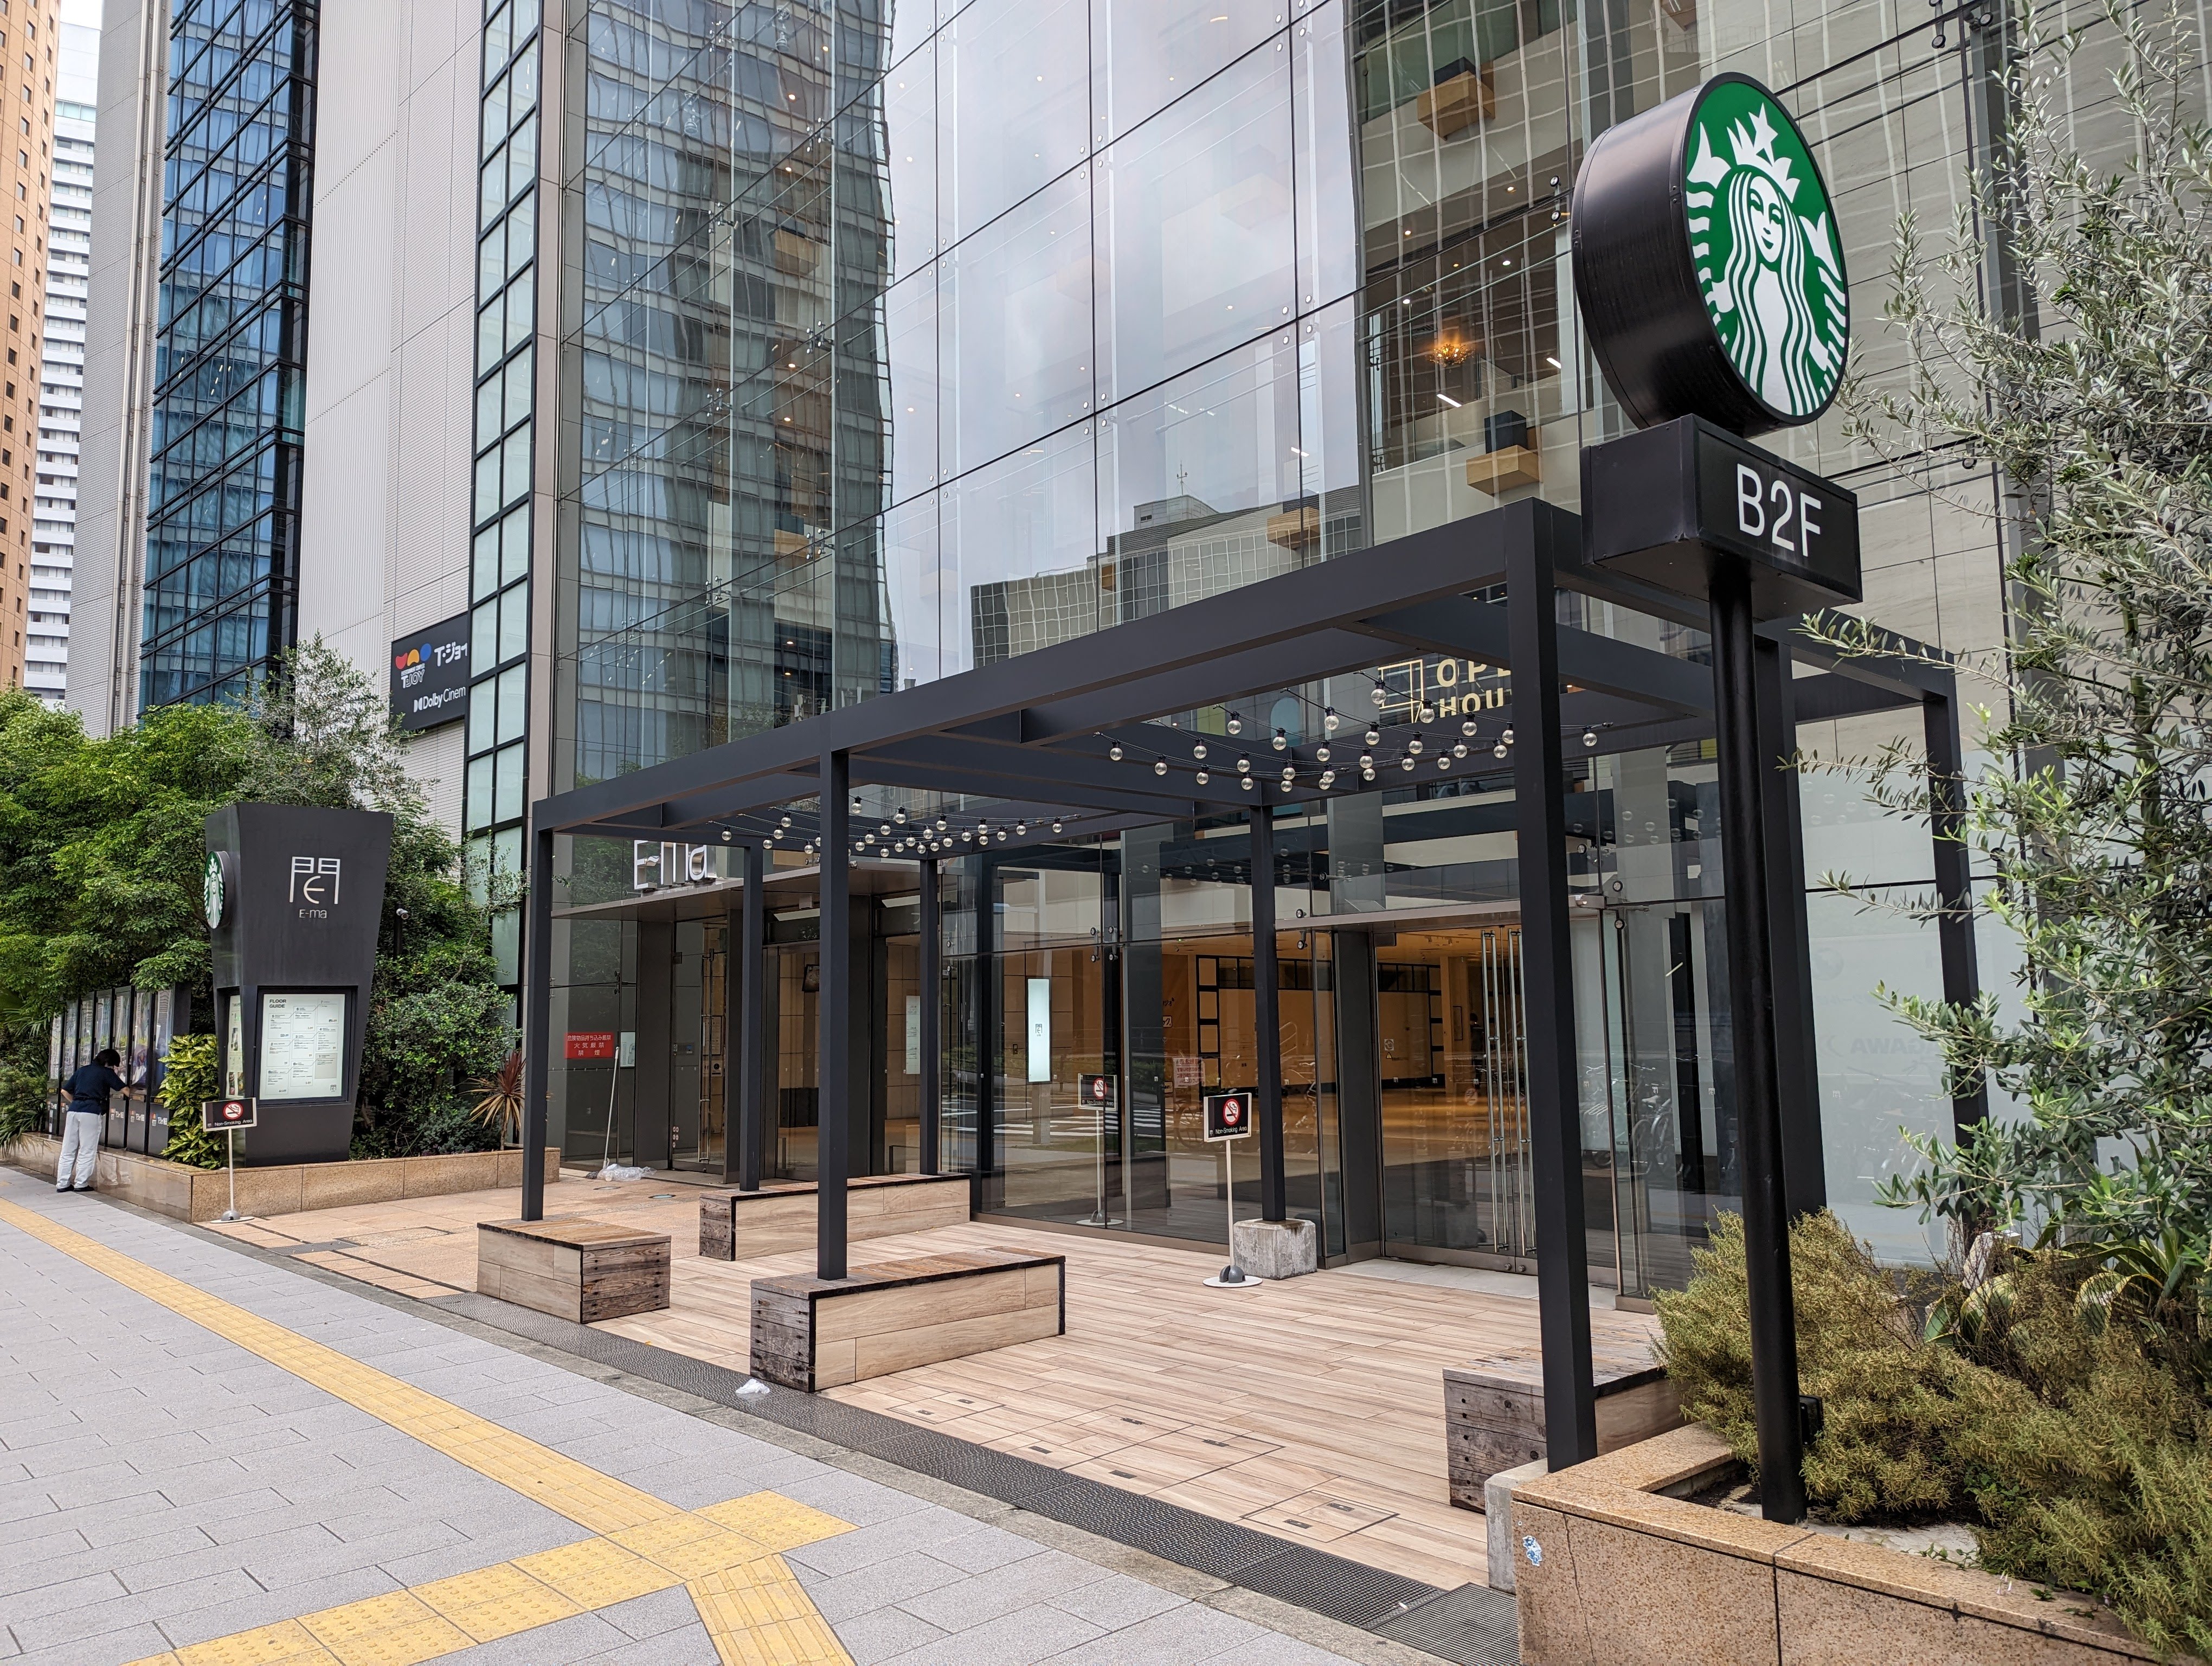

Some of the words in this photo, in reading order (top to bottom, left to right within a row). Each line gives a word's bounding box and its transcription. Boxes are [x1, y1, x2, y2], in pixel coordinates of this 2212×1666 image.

[1737, 463, 1821, 557] B2F
[423, 693, 442, 709] Dolby
[1439, 688, 1512, 718] HOU
[299, 909, 327, 919] E-ma
